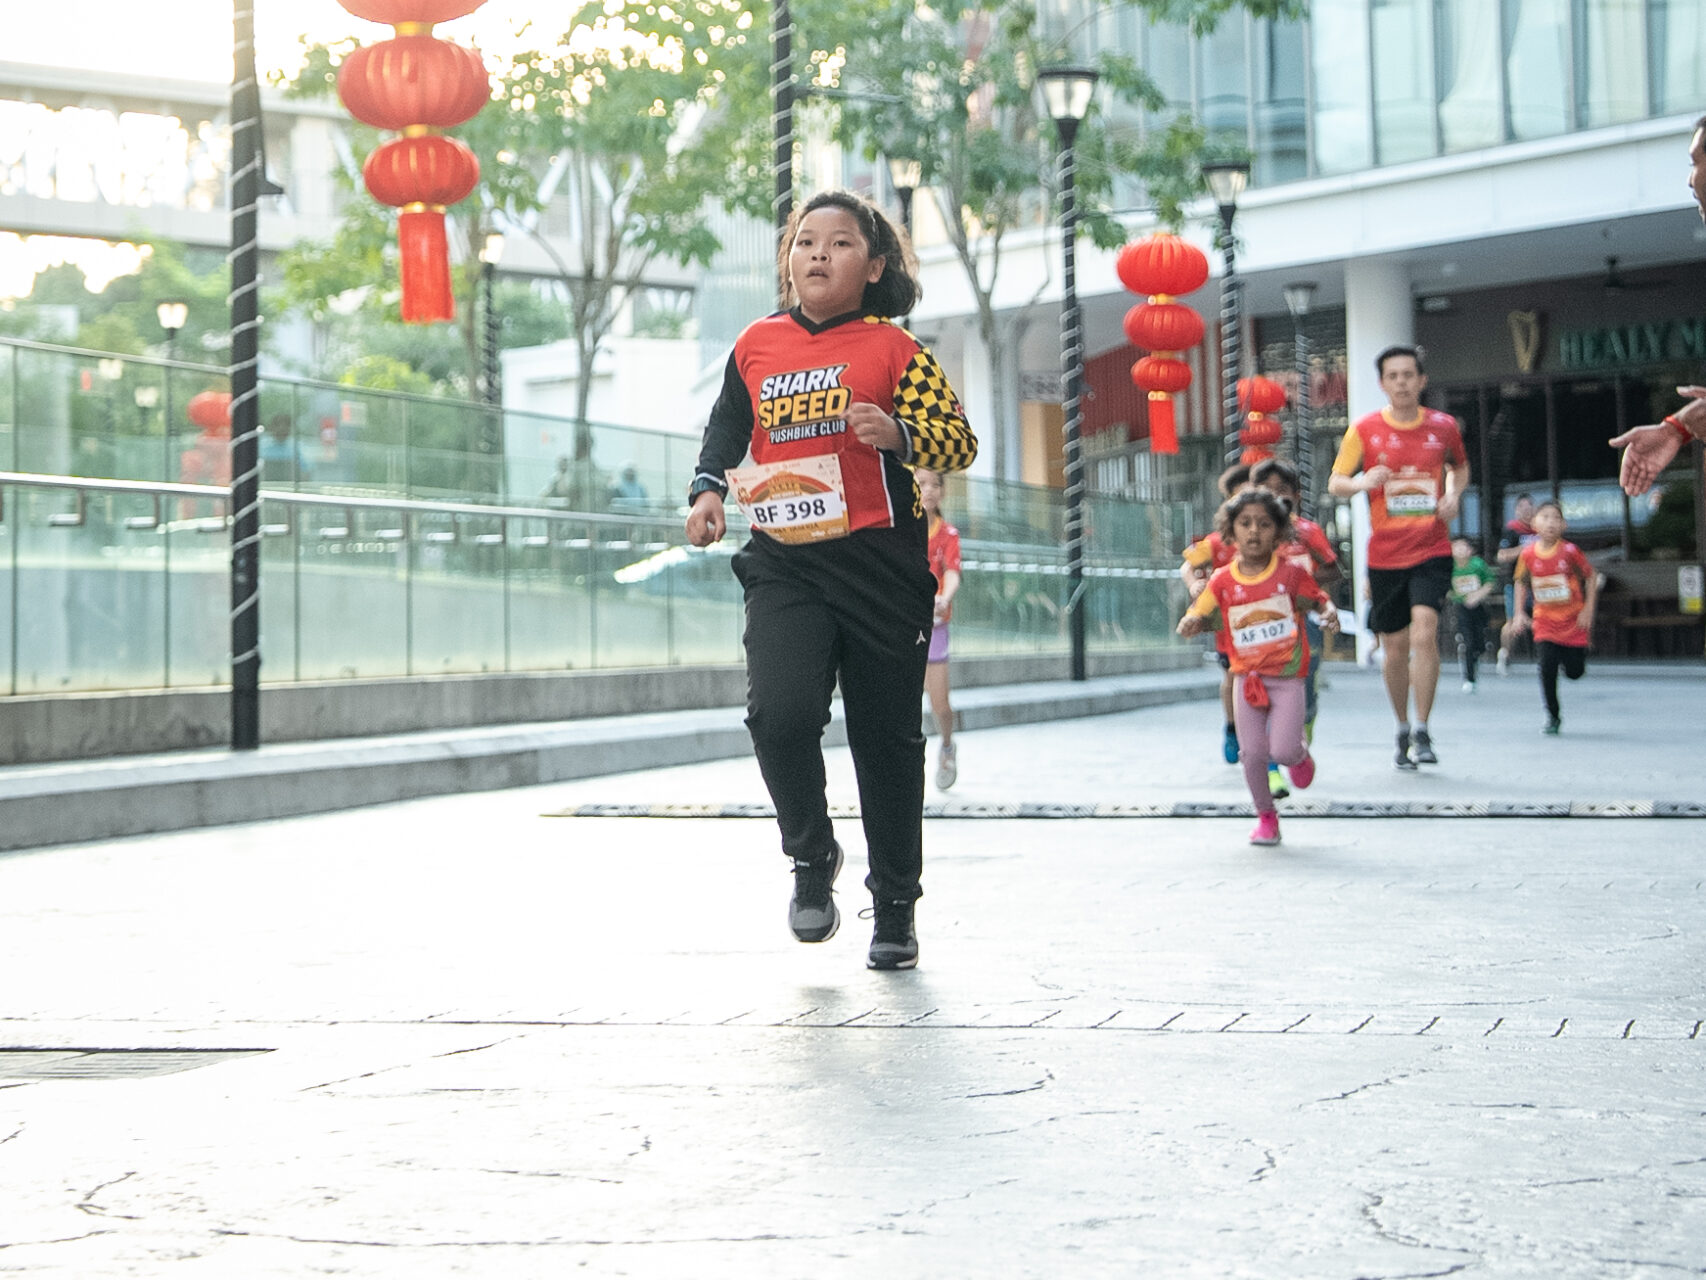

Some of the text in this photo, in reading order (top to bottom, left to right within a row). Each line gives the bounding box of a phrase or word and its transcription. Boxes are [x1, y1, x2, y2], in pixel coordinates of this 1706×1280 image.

[1559, 324, 1664, 370] HEALY
[760, 364, 848, 401] SHARK
[757, 387, 851, 430] SPEED
[769, 419, 847, 444] PUSHBIKE CLUB
[754, 498, 827, 524] BF 398
[1241, 630, 1256, 643] AF
